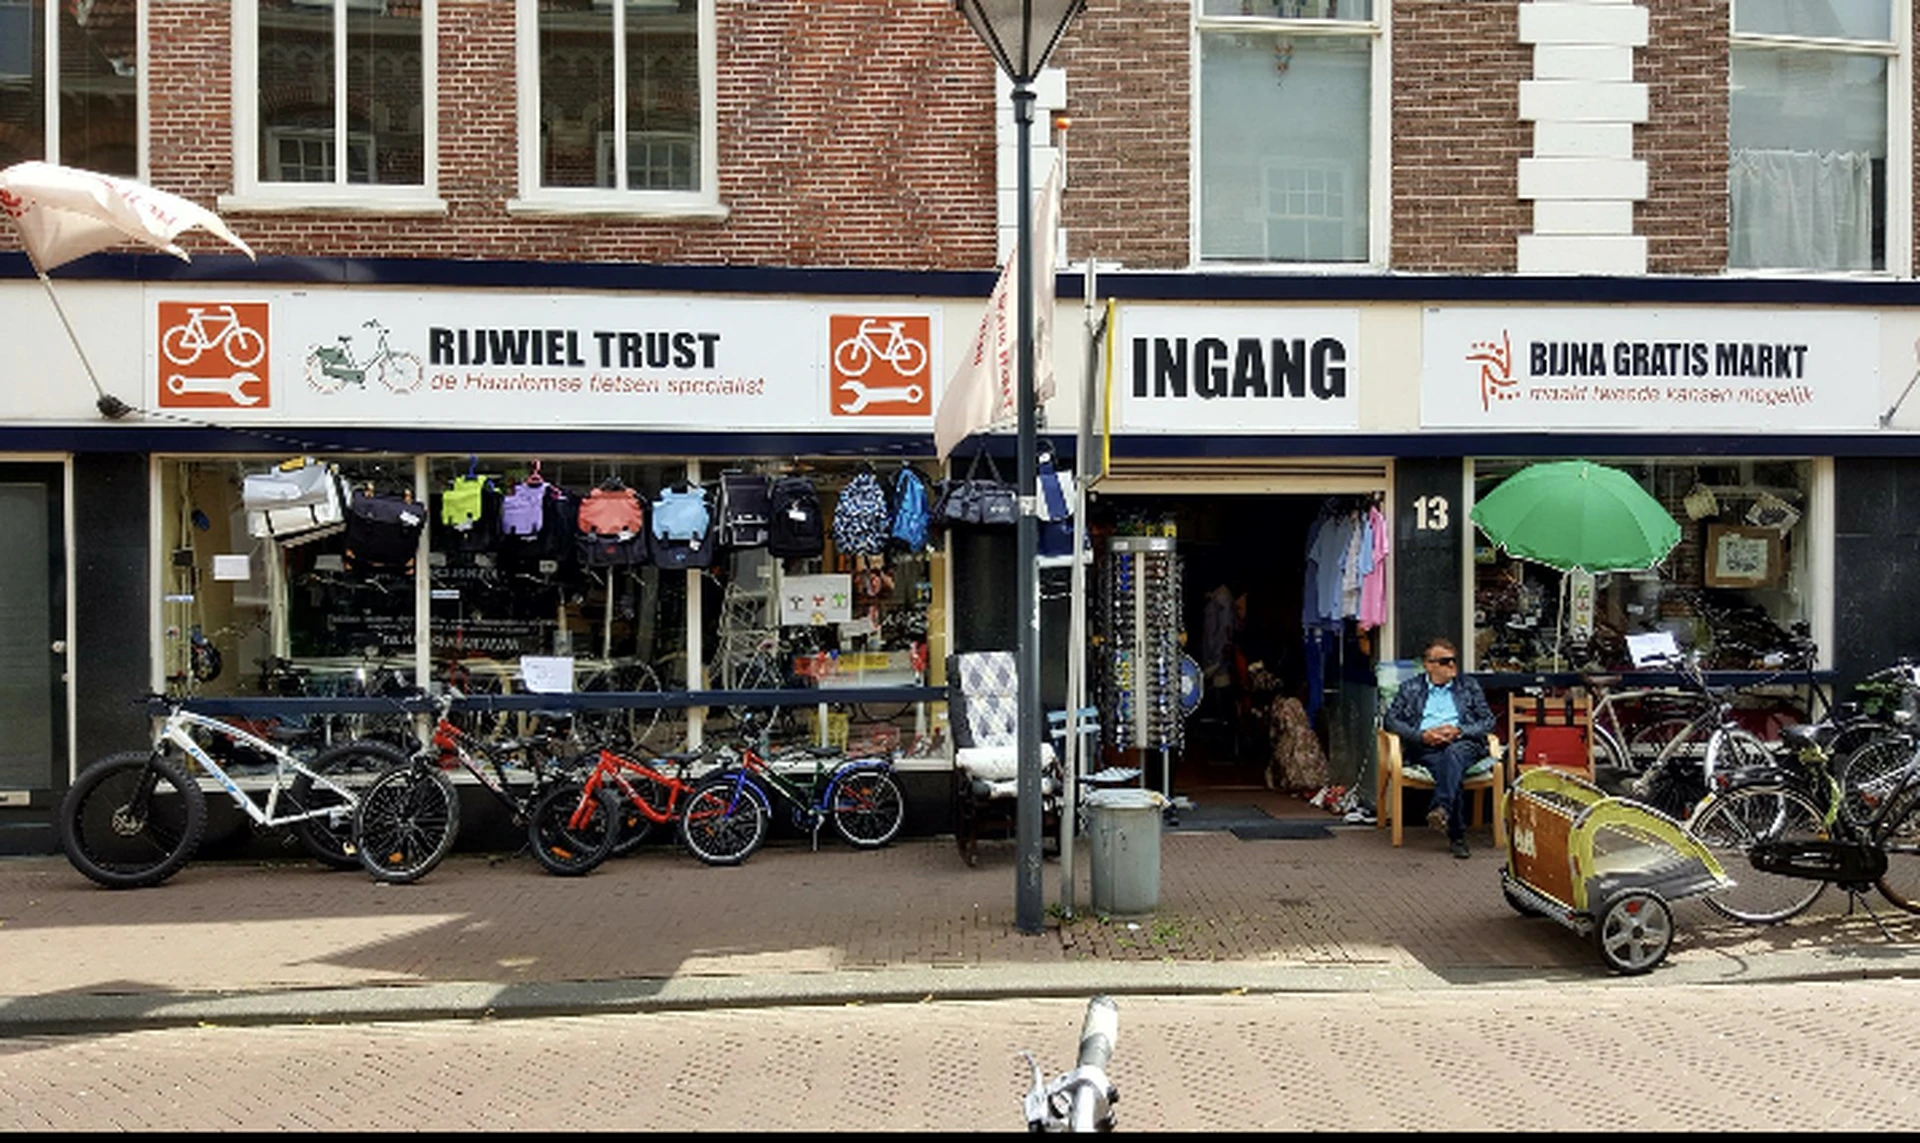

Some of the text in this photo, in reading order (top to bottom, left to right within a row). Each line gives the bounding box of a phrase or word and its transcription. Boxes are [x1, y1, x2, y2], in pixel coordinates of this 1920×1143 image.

[430, 327, 720, 368] RIJWIEL TRUST
[1530, 342, 1808, 378] BIJNA GRATIS MARKT
[431, 373, 457, 390] de
[590, 373, 659, 393] fietsen
[667, 376, 765, 396] specialist
[1133, 338, 1346, 400] INGANG
[1667, 387, 1732, 403] kansen
[1739, 386, 1813, 405] mogelijk
[1413, 496, 1449, 530] 13
